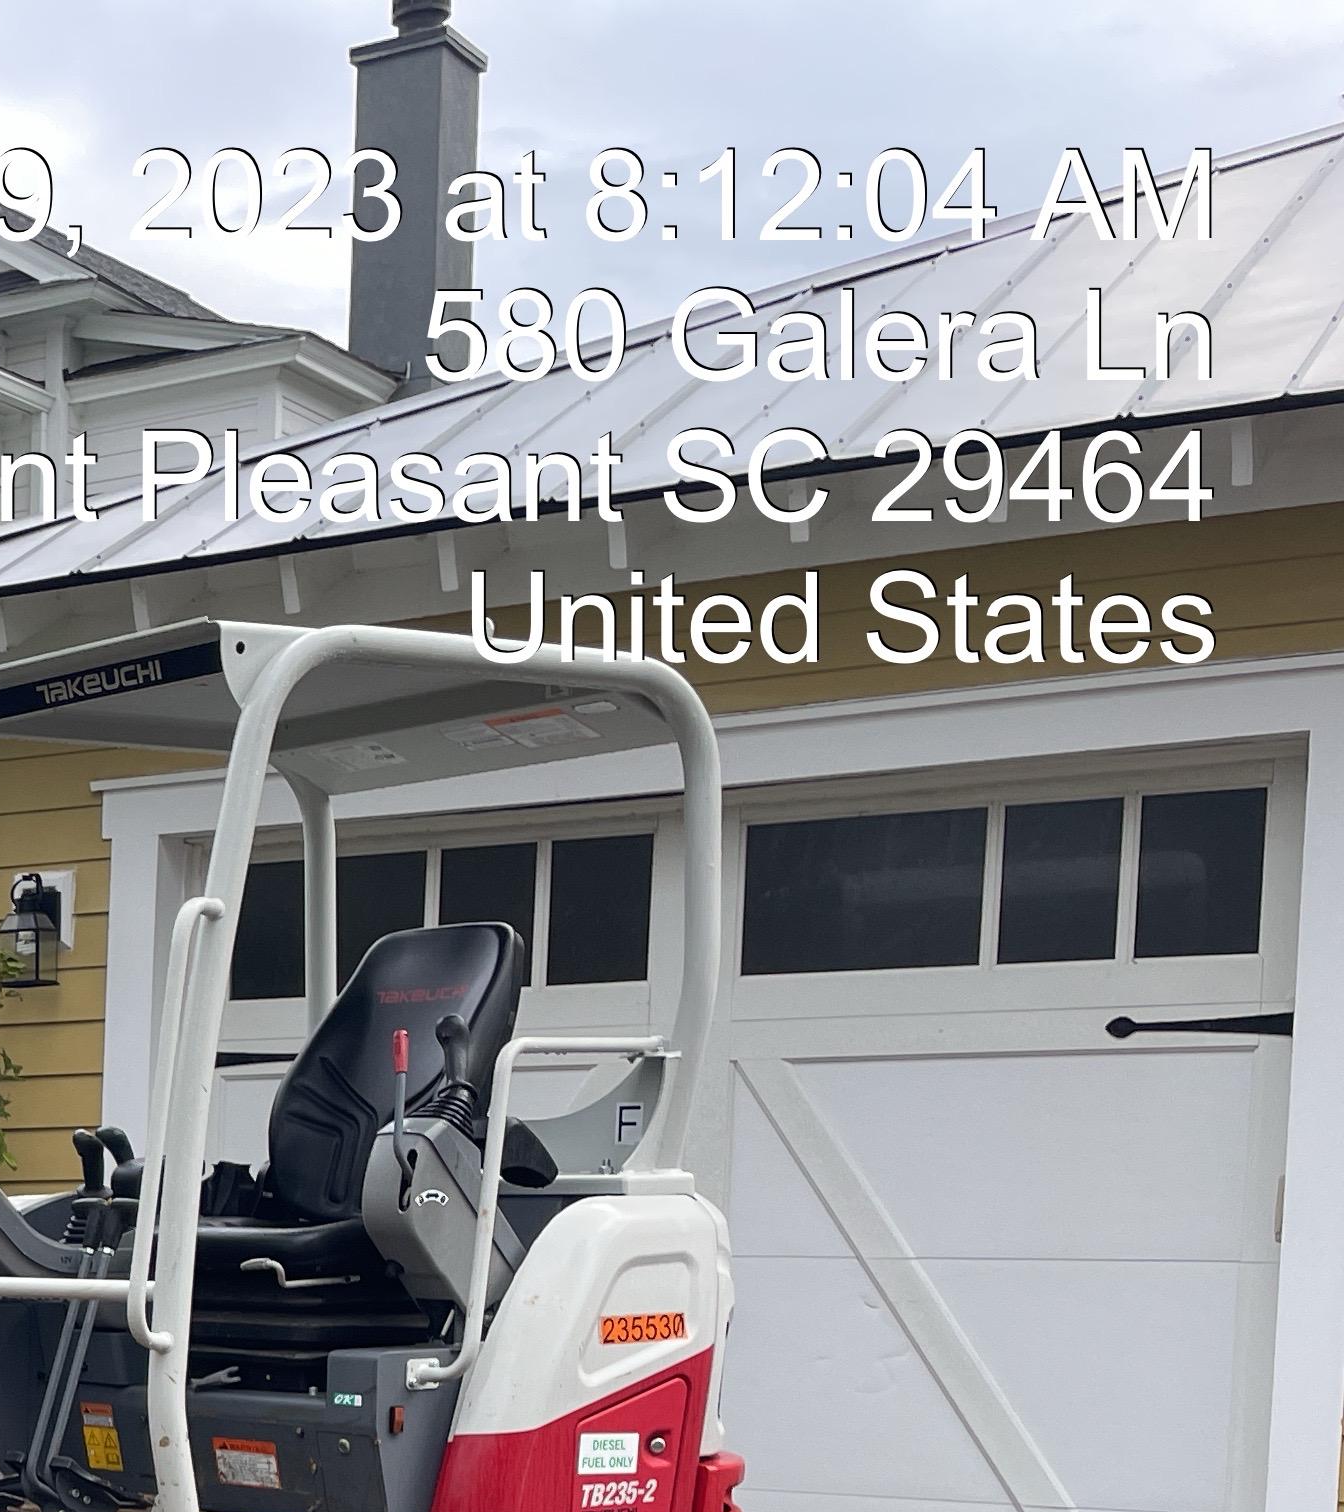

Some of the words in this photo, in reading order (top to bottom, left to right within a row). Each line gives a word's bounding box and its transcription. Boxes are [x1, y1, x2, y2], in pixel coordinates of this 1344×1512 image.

[35, 659, 163, 705] TAKEUCHI
[602, 1313, 686, 1344] 235530
[592, 1439, 626, 1451] DIESEL
[581, 1457, 607, 1469] FUEL
[608, 1456, 634, 1468] ONLY
[581, 1478, 658, 1509] TB235-2
